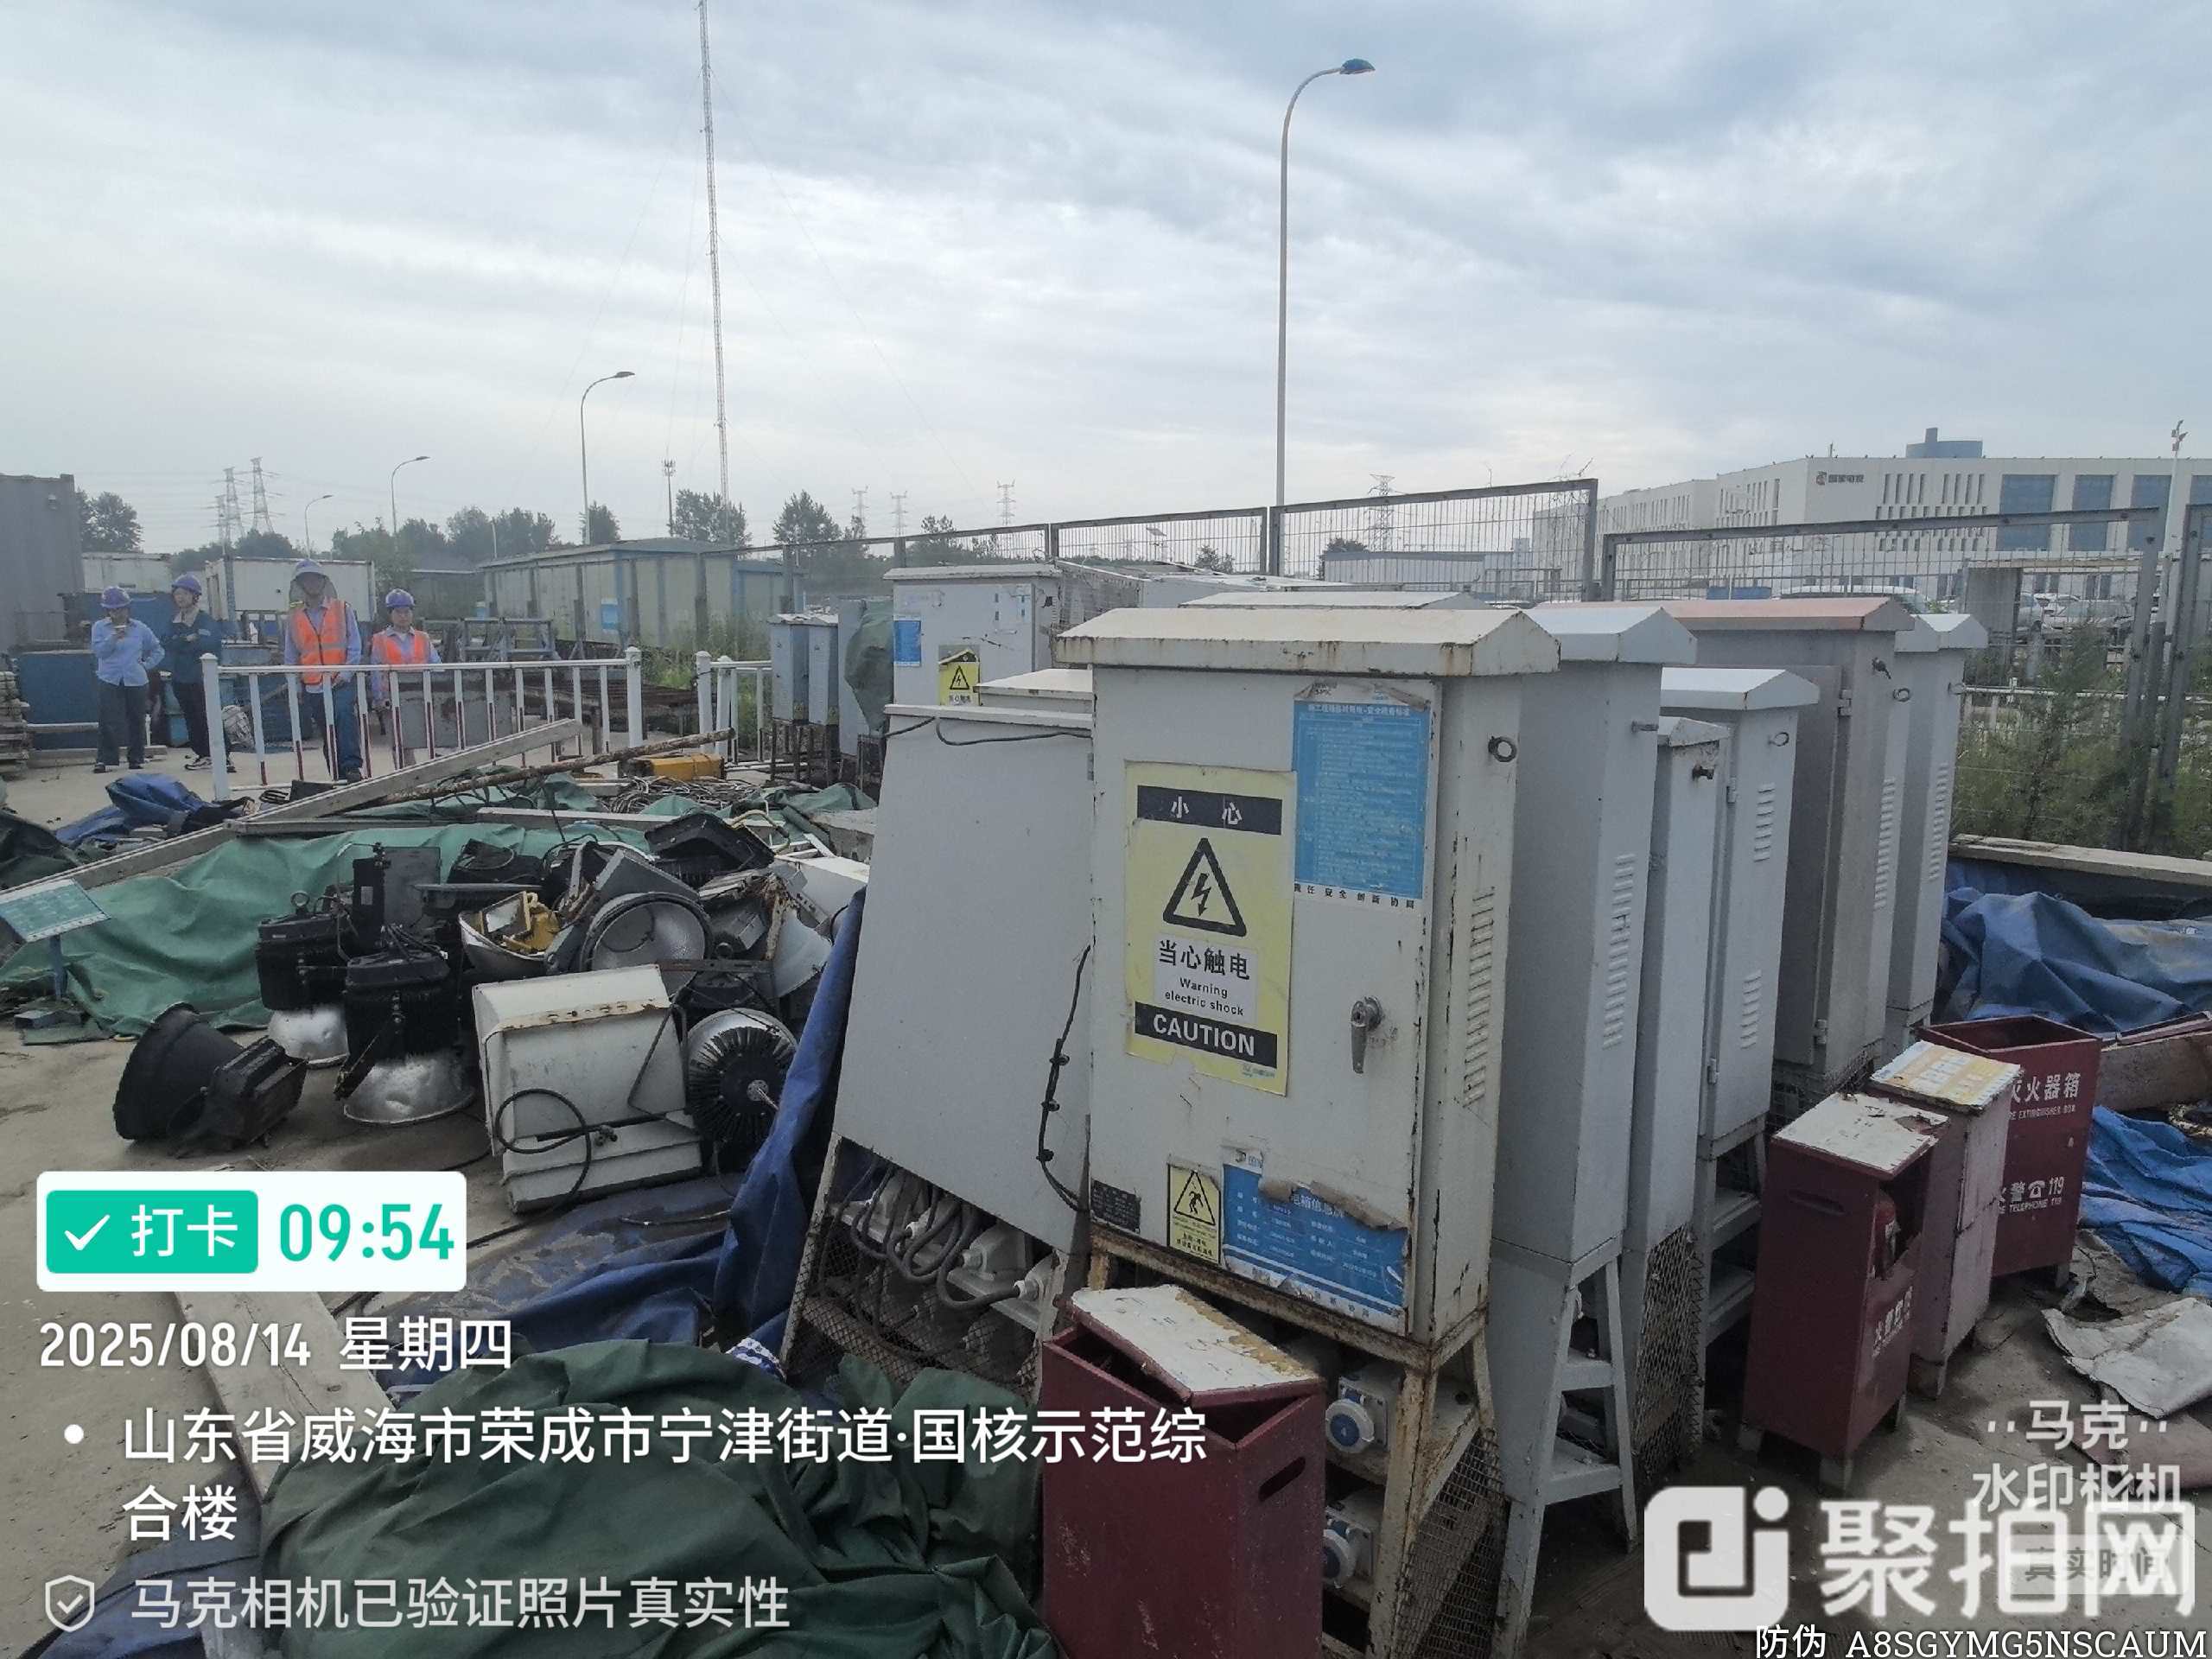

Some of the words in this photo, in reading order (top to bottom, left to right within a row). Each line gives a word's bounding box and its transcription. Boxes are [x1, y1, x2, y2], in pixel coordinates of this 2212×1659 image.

[1159, 939, 1250, 981] 当心触电
[1165, 991, 1206, 1008] electric
[1210, 1000, 1244, 1017] shock
[1179, 977, 1228, 1000] Warning
[1154, 1013, 1255, 1058] CAUTION
